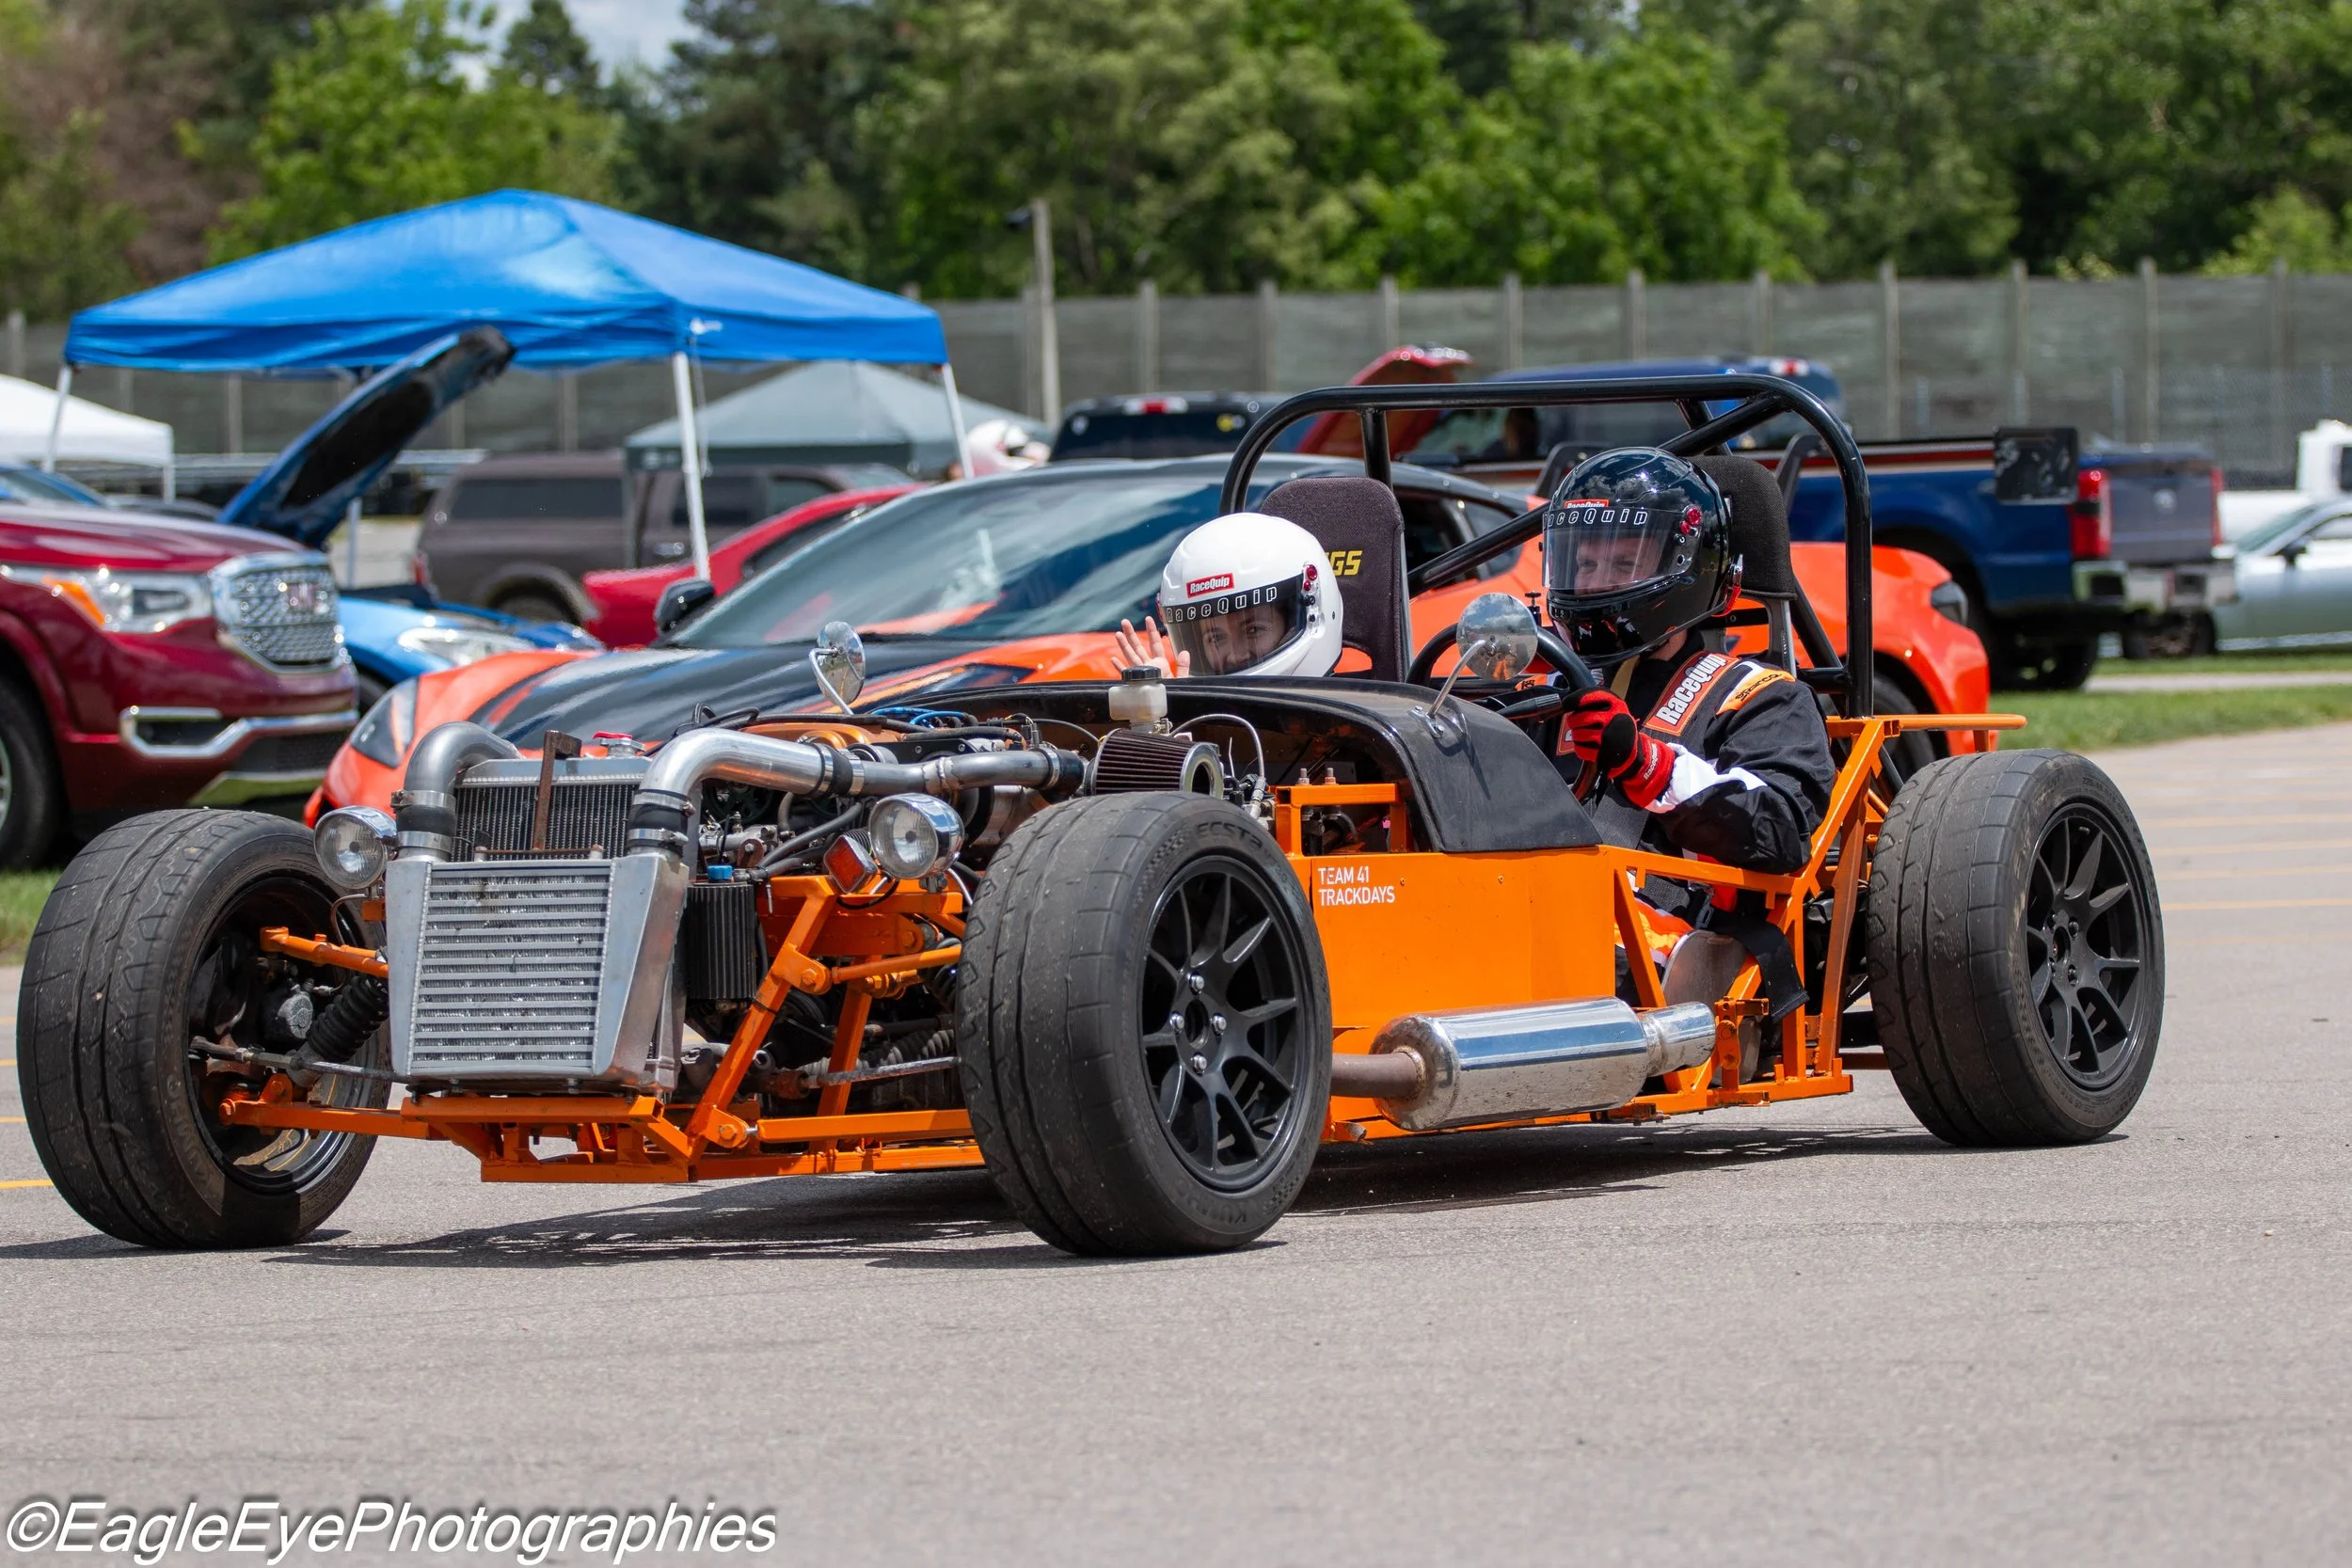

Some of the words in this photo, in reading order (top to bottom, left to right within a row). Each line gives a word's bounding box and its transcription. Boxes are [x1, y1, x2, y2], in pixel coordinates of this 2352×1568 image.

[1325, 550, 1363, 576] GS
[1189, 576, 1230, 594] RaceQuip
[1167, 586, 1278, 623] RaceQuip
[1655, 653, 1728, 725] RaceQuip
[1318, 866, 1355, 885] TEAM
[1357, 865, 1370, 884] 41
[1318, 885, 1395, 906] TRACKDAYS
